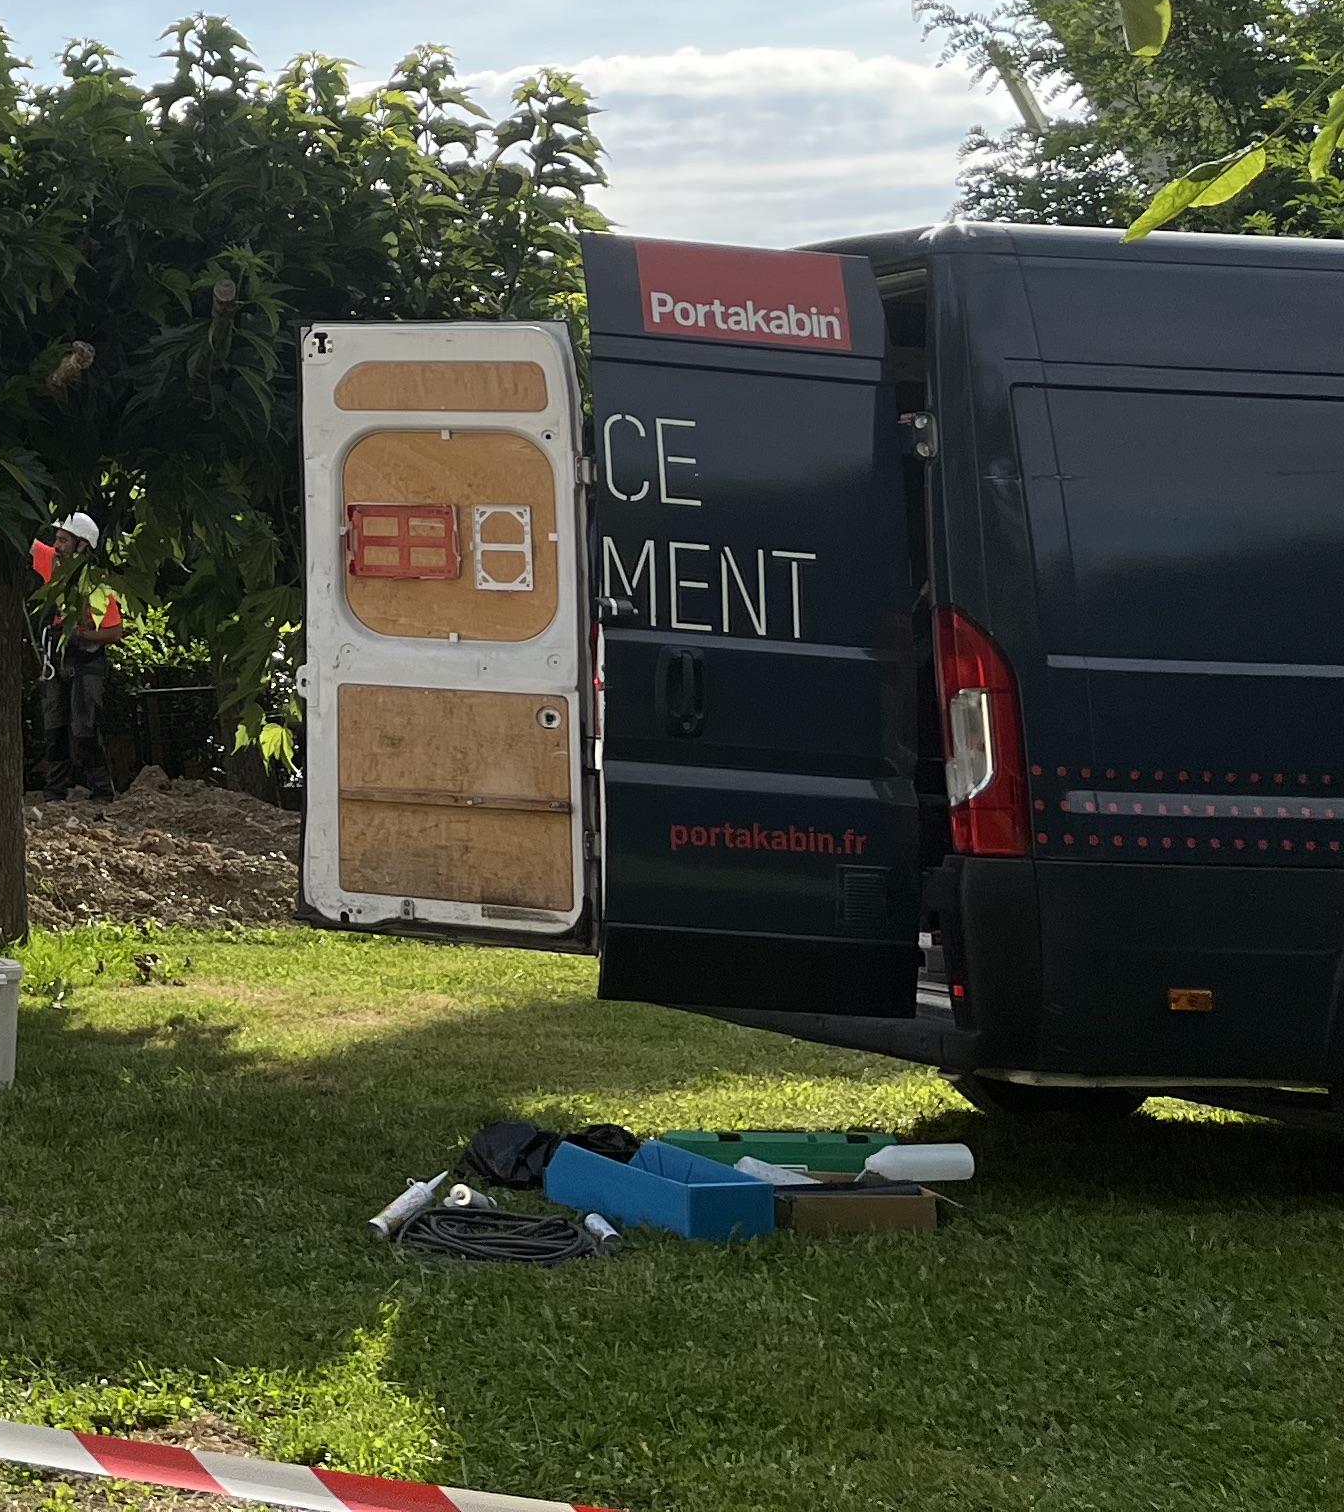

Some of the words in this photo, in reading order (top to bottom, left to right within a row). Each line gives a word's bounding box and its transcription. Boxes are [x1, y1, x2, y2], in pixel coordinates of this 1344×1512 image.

[650, 291, 842, 340] Portakabin
[603, 413, 702, 507] CE
[602, 536, 817, 639] MENT
[670, 822, 868, 855] portakabin.fr
